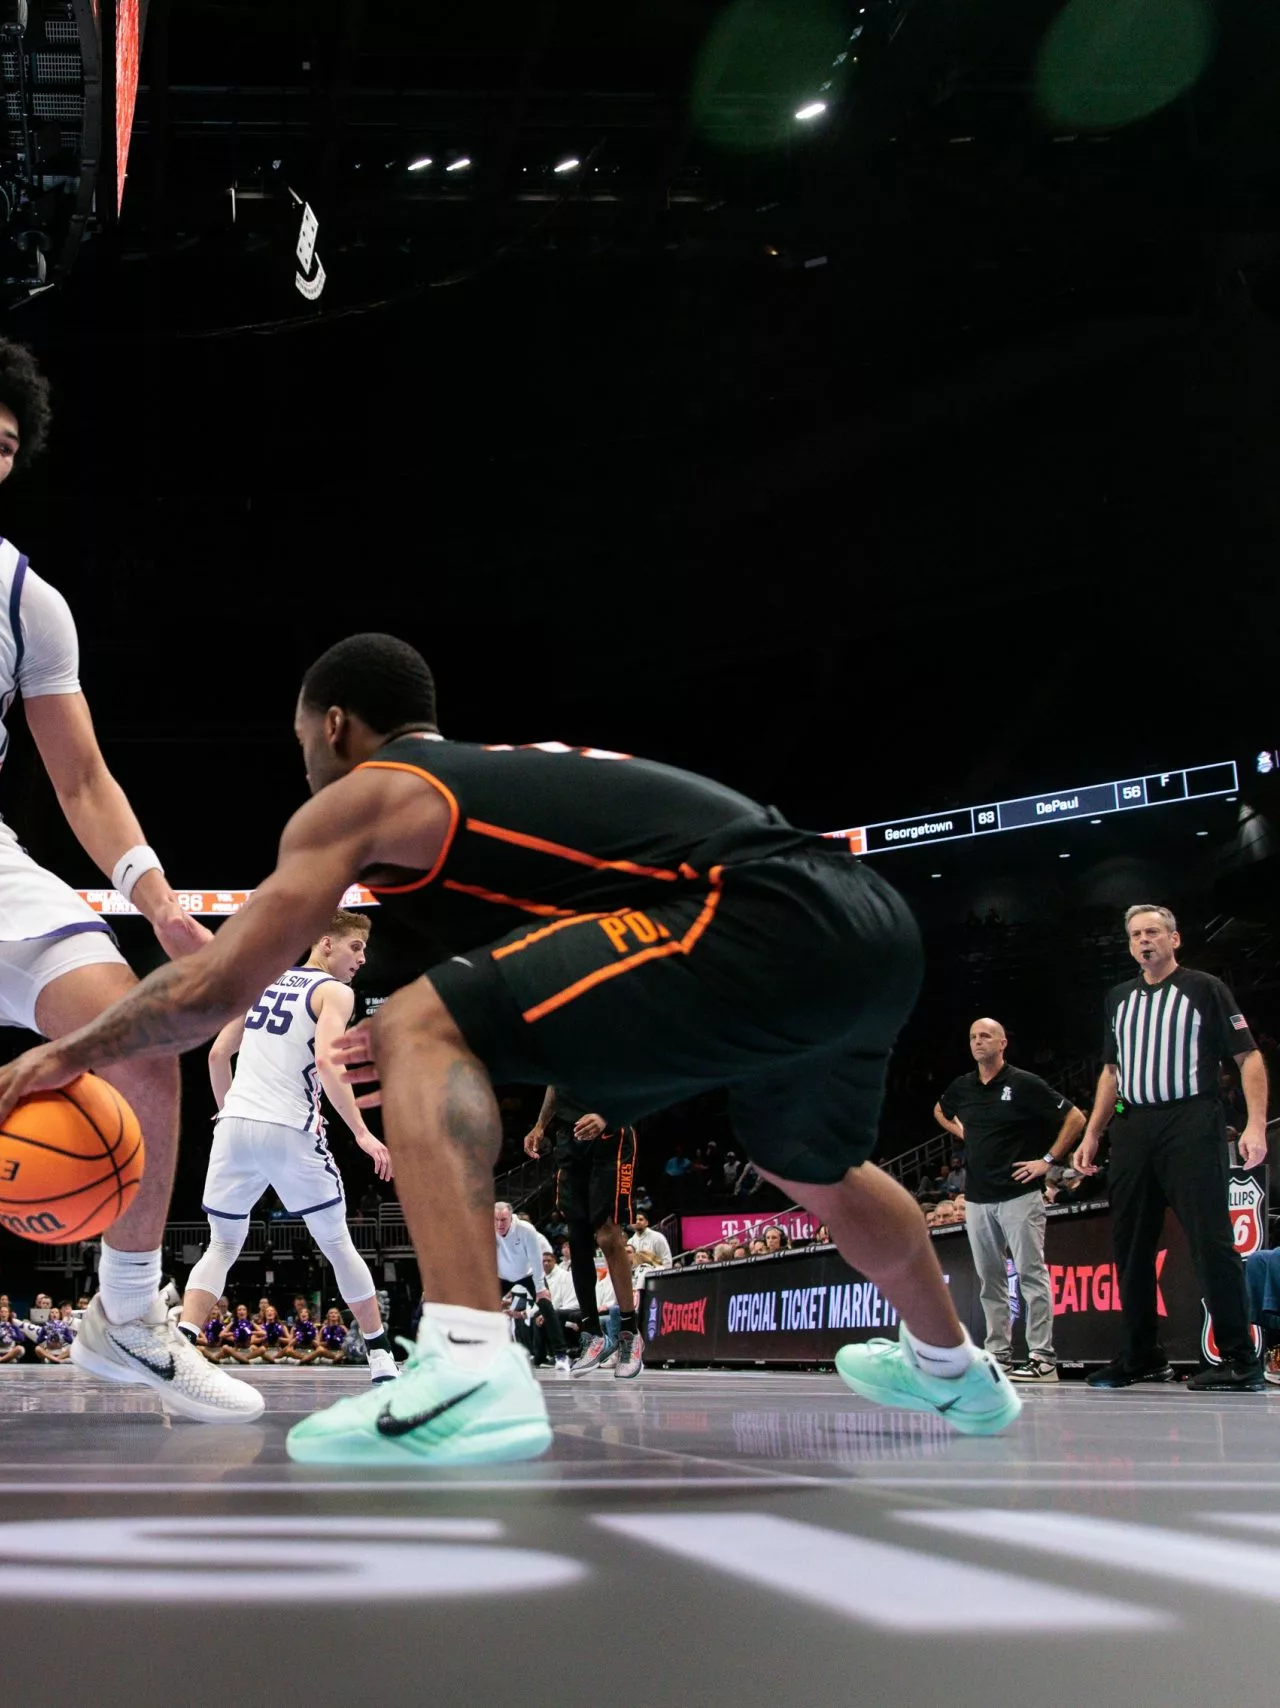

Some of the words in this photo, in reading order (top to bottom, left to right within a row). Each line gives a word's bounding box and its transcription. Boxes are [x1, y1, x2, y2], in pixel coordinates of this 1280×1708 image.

[1122, 785, 1141, 800] 56
[1036, 796, 1079, 815] DePaul
[978, 812, 995, 825] 63
[885, 819, 953, 841] Georgetown
[244, 990, 300, 1036] 55
[621, 1163, 632, 1195] POKES
[1229, 1191, 1255, 1207] LLIPS
[1233, 1214, 1251, 1246] 6
[661, 1297, 707, 1335] SEATGEEK
[728, 1290, 777, 1333] OFFICIAL
[781, 1285, 827, 1330] TICKET
